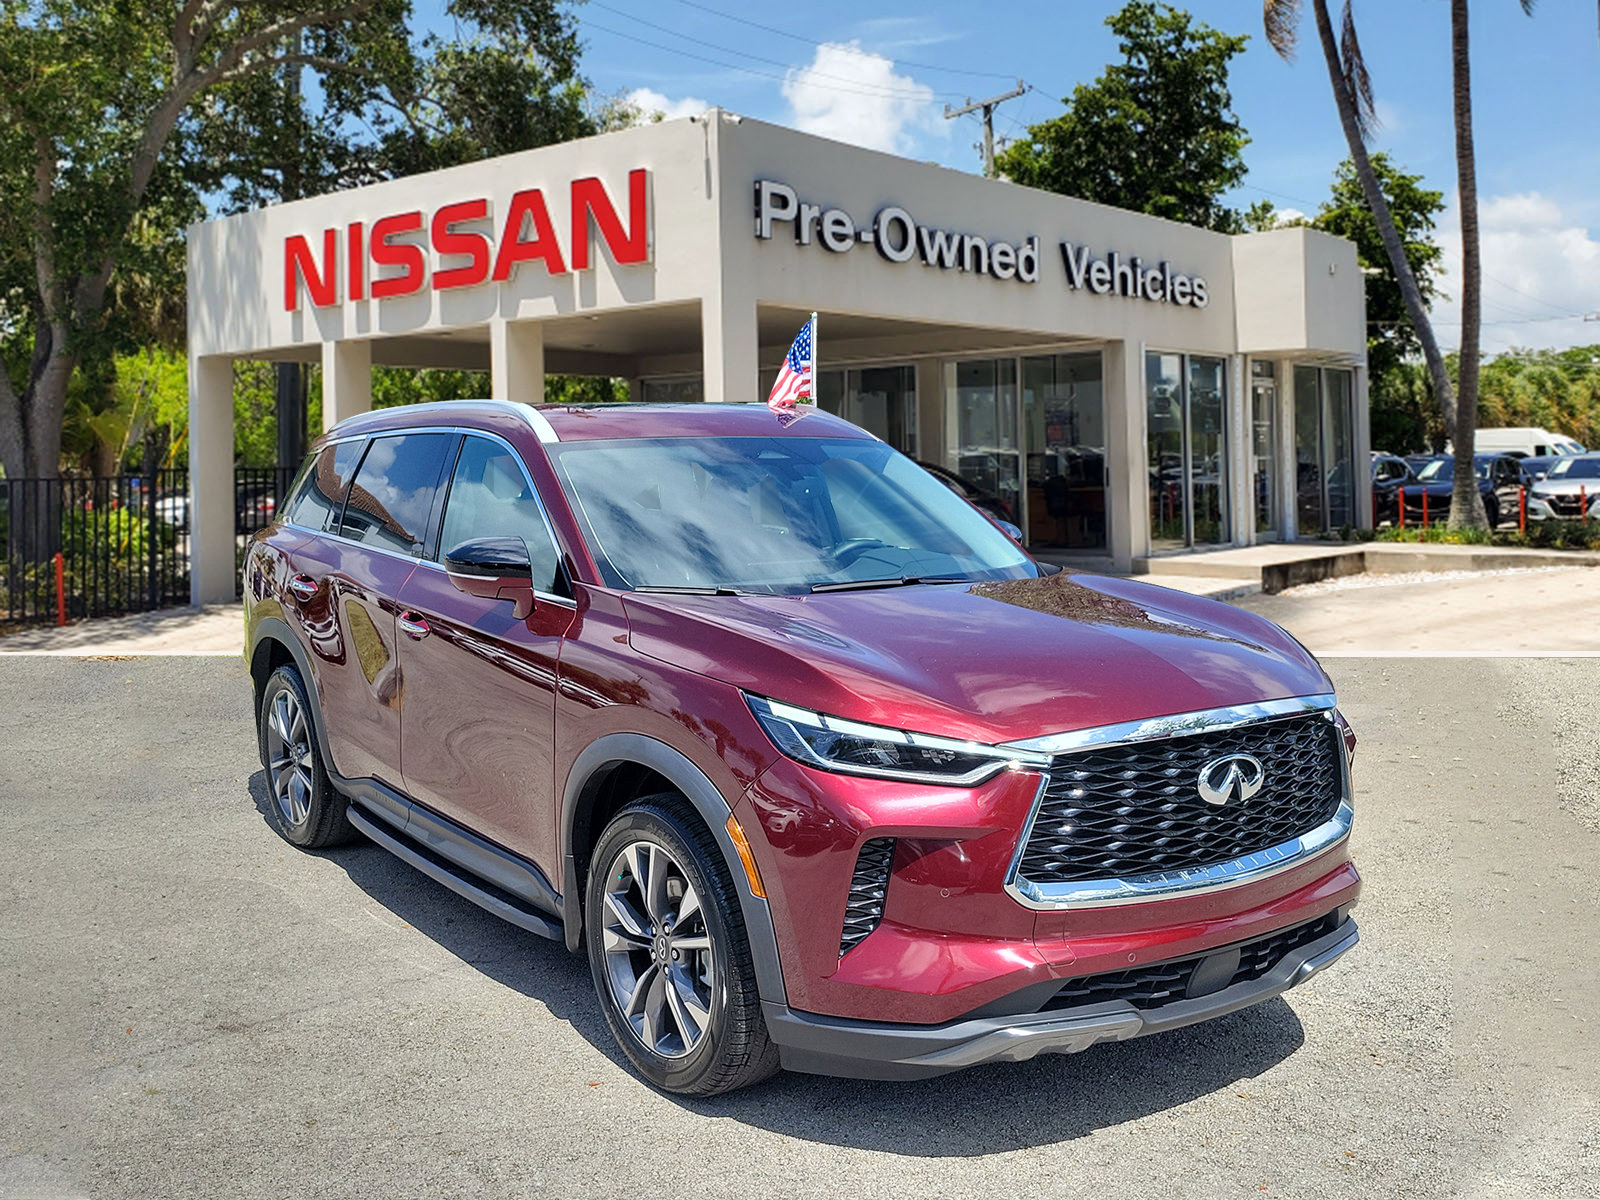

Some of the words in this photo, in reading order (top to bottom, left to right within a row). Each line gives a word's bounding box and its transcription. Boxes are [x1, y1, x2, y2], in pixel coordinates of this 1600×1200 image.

[285, 168, 648, 312] NISSAN
[755, 179, 1040, 284] Pre-Owned
[1060, 242, 1210, 308] Vehicles
